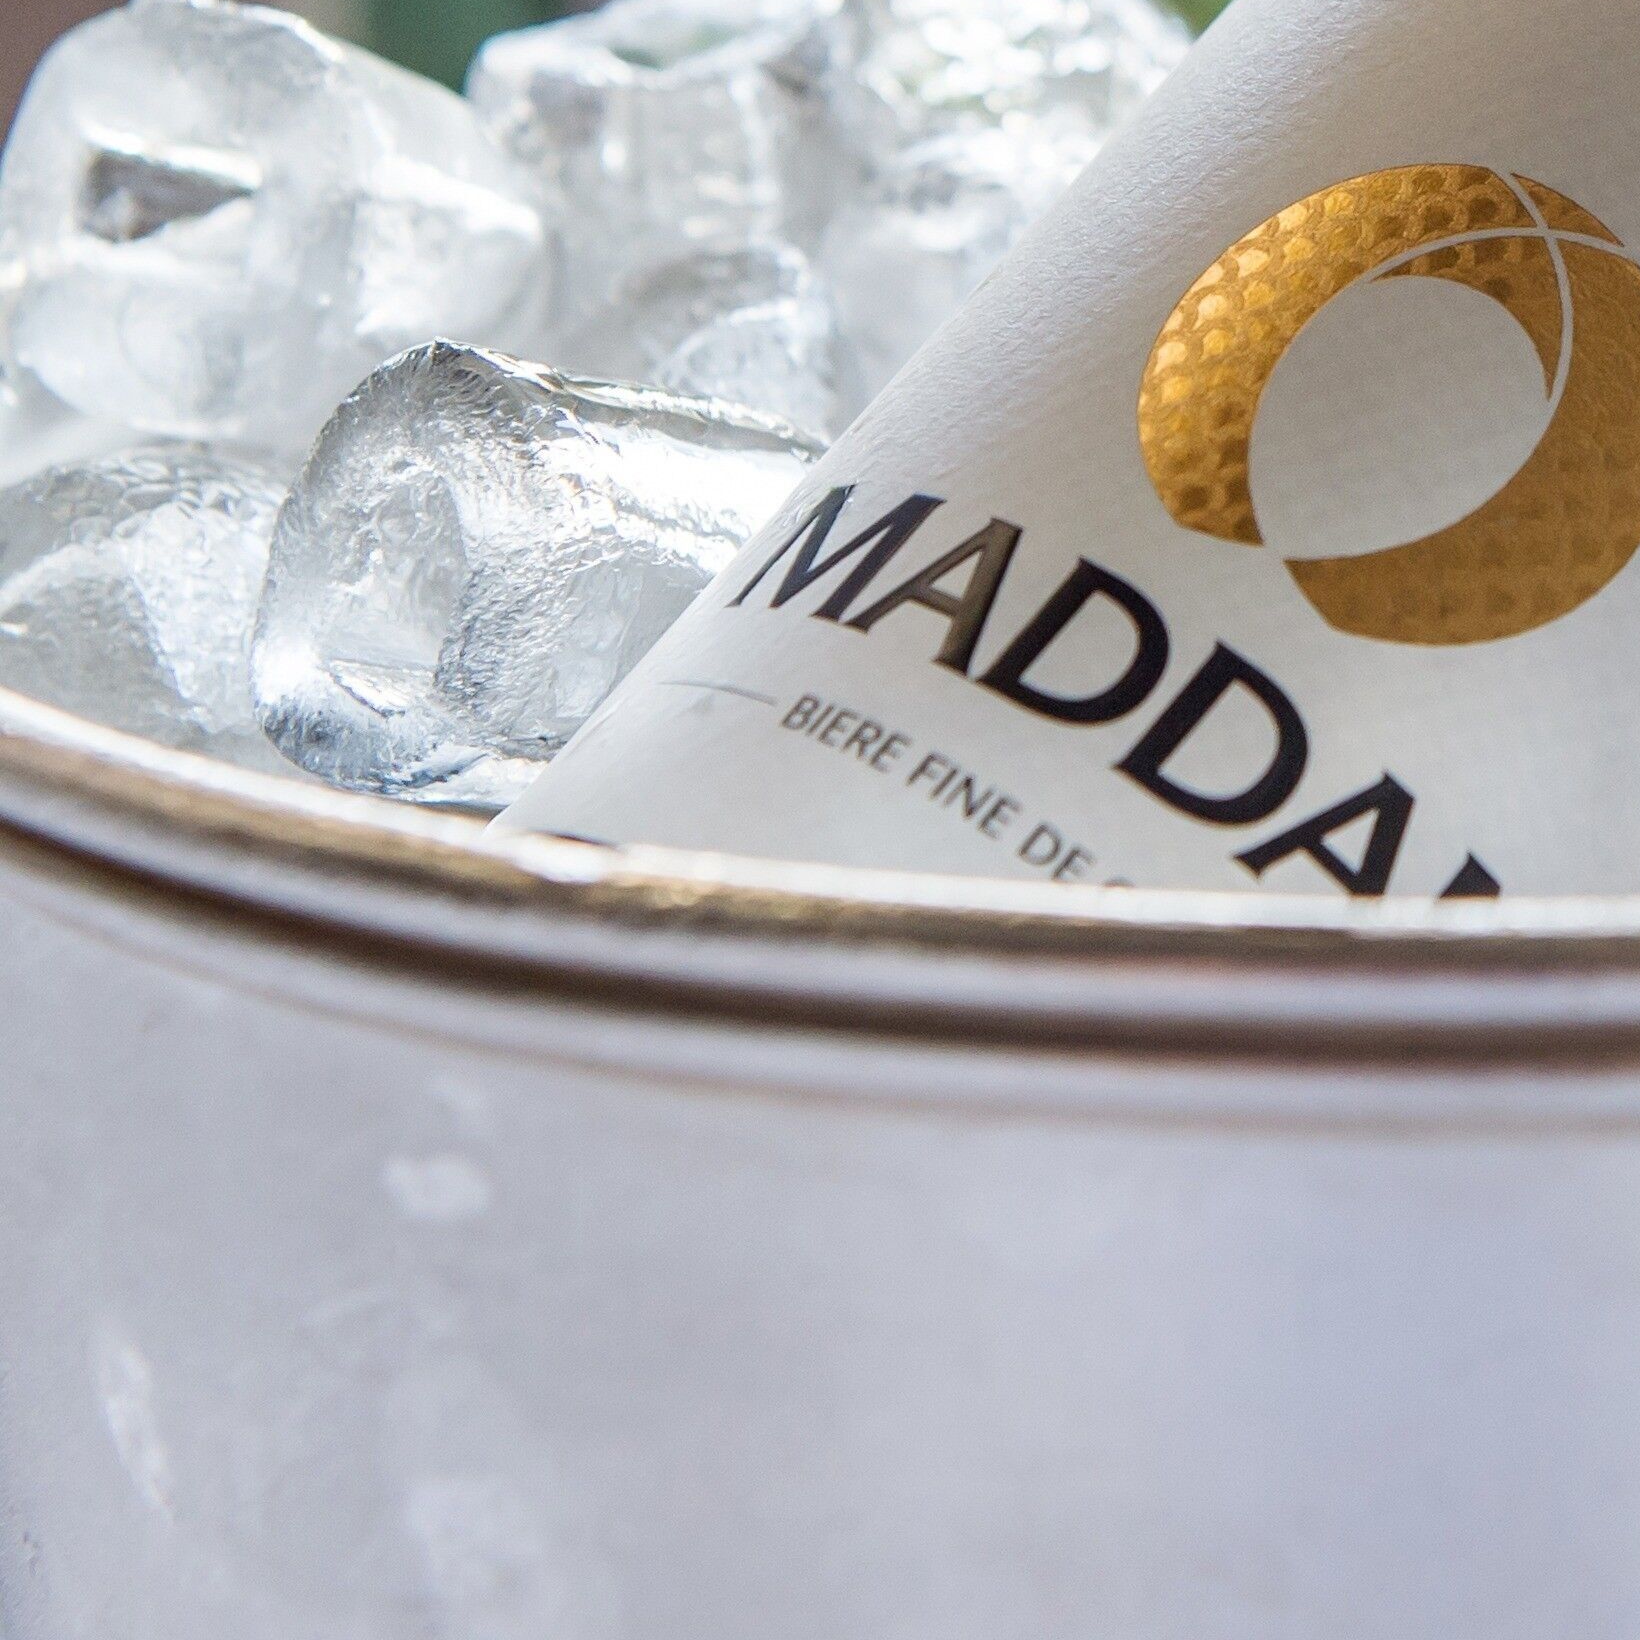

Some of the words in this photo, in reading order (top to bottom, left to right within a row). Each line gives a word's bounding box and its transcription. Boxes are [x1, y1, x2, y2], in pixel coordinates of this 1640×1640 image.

[725, 484, 1502, 899] MADDA
[781, 693, 912, 774] BIERE
[906, 752, 1020, 840] FINE
[1016, 824, 1094, 884] DE
